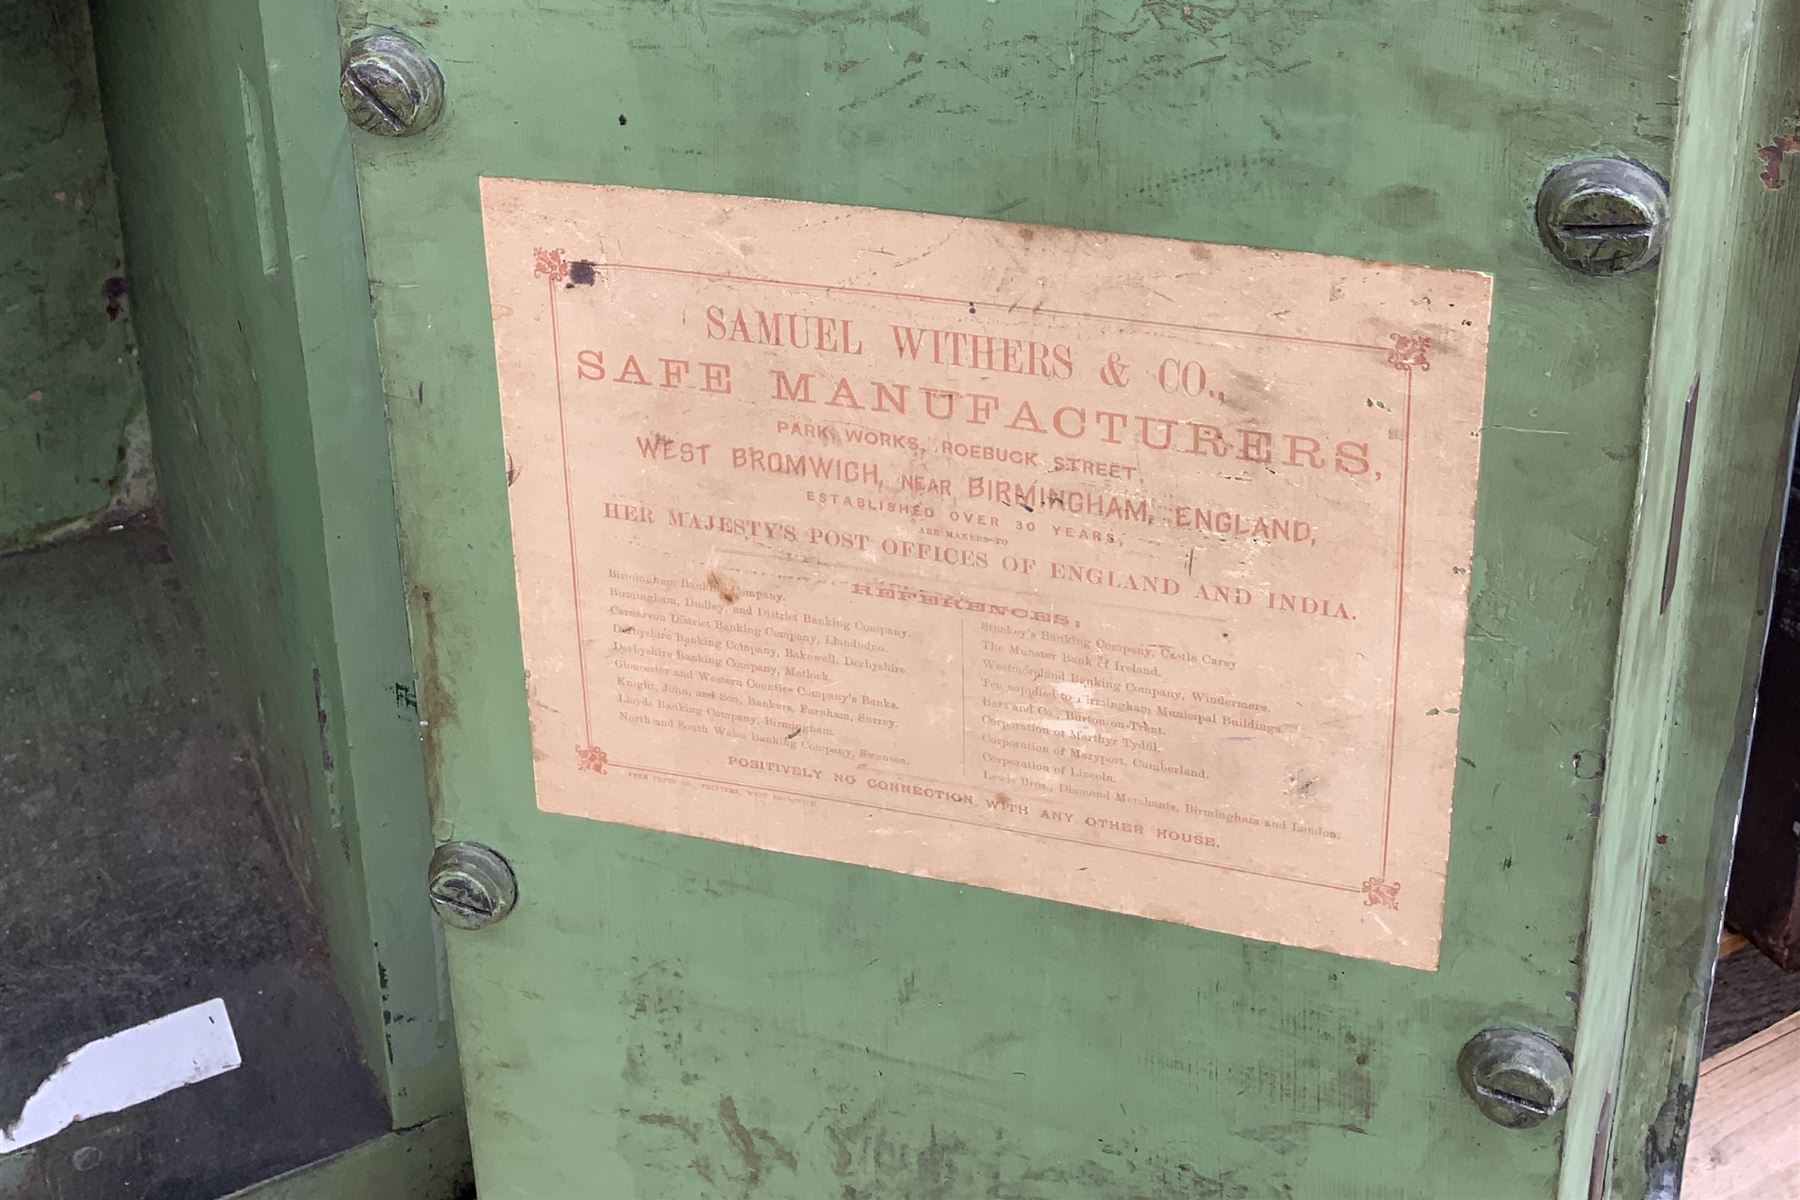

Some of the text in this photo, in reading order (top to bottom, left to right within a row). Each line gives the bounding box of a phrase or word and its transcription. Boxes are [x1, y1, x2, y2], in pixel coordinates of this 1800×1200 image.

[705, 304, 1226, 404] SAMUEL WITHERS & CO.,
[575, 346, 1385, 480] SAFE MANUFACTURERS,
[844, 427, 925, 454] WORKS,
[940, 439, 1038, 467] ROEBUCK
[635, 433, 1318, 549] WEST BROMWICH, NEAR BIRMINGHAM, ENGLAND,
[805, 489, 935, 519] ESTABLISHED
[950, 510, 1000, 529] OVER
[1015, 518, 1036, 534] 30
[602, 499, 1359, 622] HER MAJESTY'S POST OFFICES OF ENGLAND AND INDIA.
[732, 602, 752, 617] and
[756, 606, 798, 623] District
[802, 612, 850, 631] Banking
[849, 581, 1081, 629] REFERENCES:
[670, 612, 711, 629] District
[714, 619, 761, 637] Banking
[675, 631, 722, 650] Banking
[1040, 629, 1092, 650] Banking
[676, 649, 723, 668] Banking
[1061, 651, 1092, 667] Bank
[672, 666, 693, 680] and
[1070, 672, 1121, 692] Banking
[695, 687, 715, 700] and
[618, 710, 651, 725] North
[654, 716, 674, 729] and
[656, 698, 703, 717] Banking
[981, 714, 1050, 737] Corporation
[981, 732, 1049, 755] Corporation
[1052, 744, 1066, 756] of
[981, 751, 1049, 774] Corporation
[1052, 763, 1065, 775] of
[728, 754, 1221, 849] POSITIVELY NO CONNECTION WITH ANY OTHER HOUSE.
[1263, 816, 1286, 831] and
